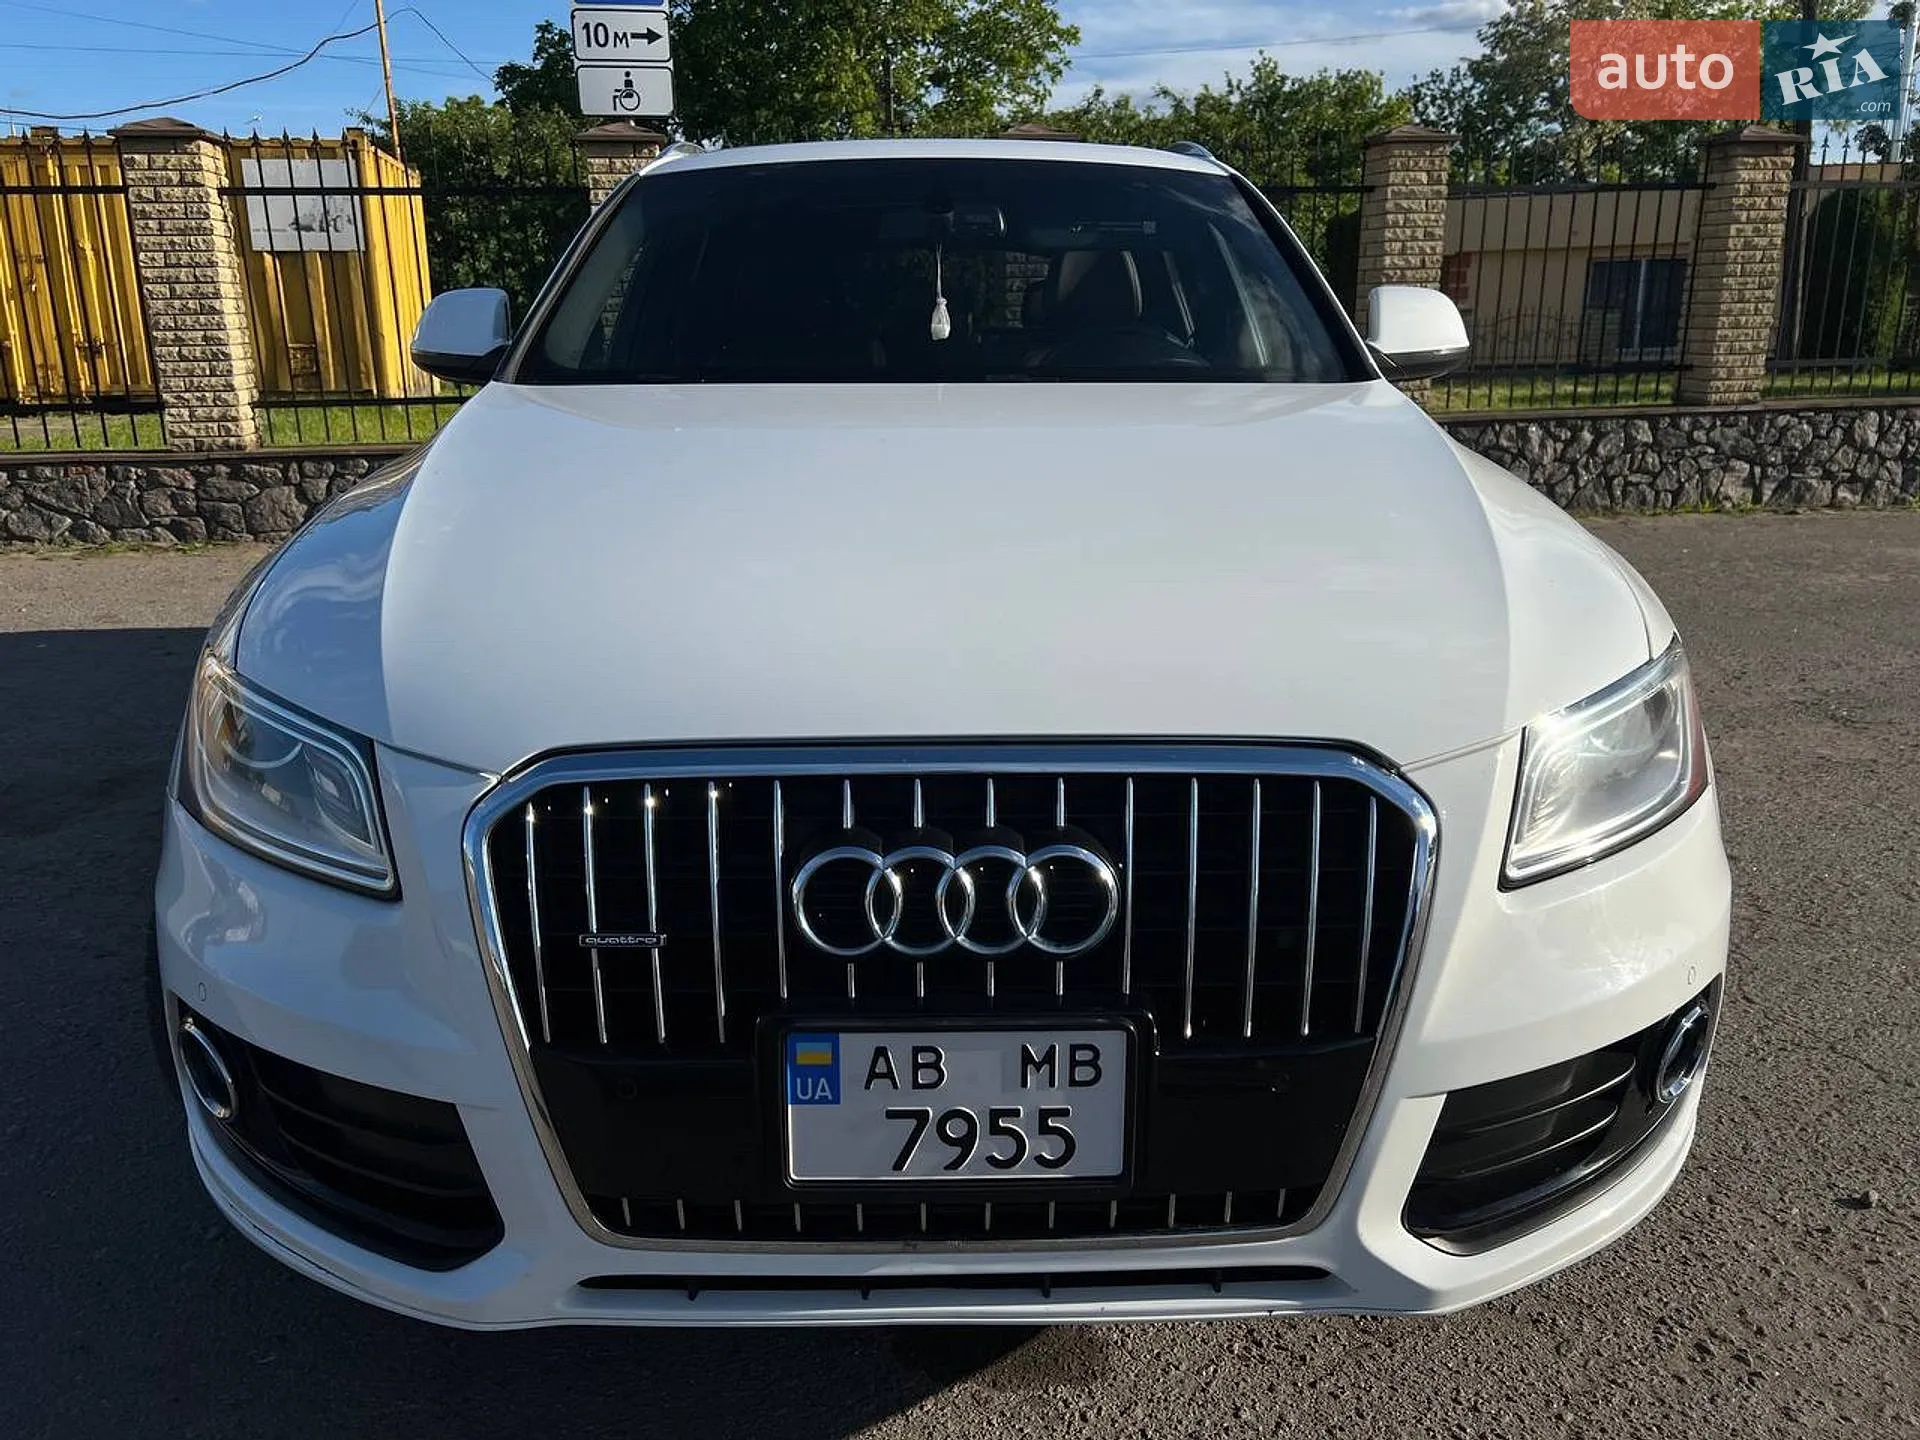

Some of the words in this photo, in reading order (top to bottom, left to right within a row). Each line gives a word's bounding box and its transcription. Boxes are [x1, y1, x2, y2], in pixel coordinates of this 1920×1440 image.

[582, 22, 609, 48] 10
[585, 936, 657, 945] quattro
[864, 1045, 947, 1090] AB
[1020, 1042, 1103, 1089] MB
[796, 1077, 833, 1100] UA
[885, 1106, 1077, 1171] 7955
